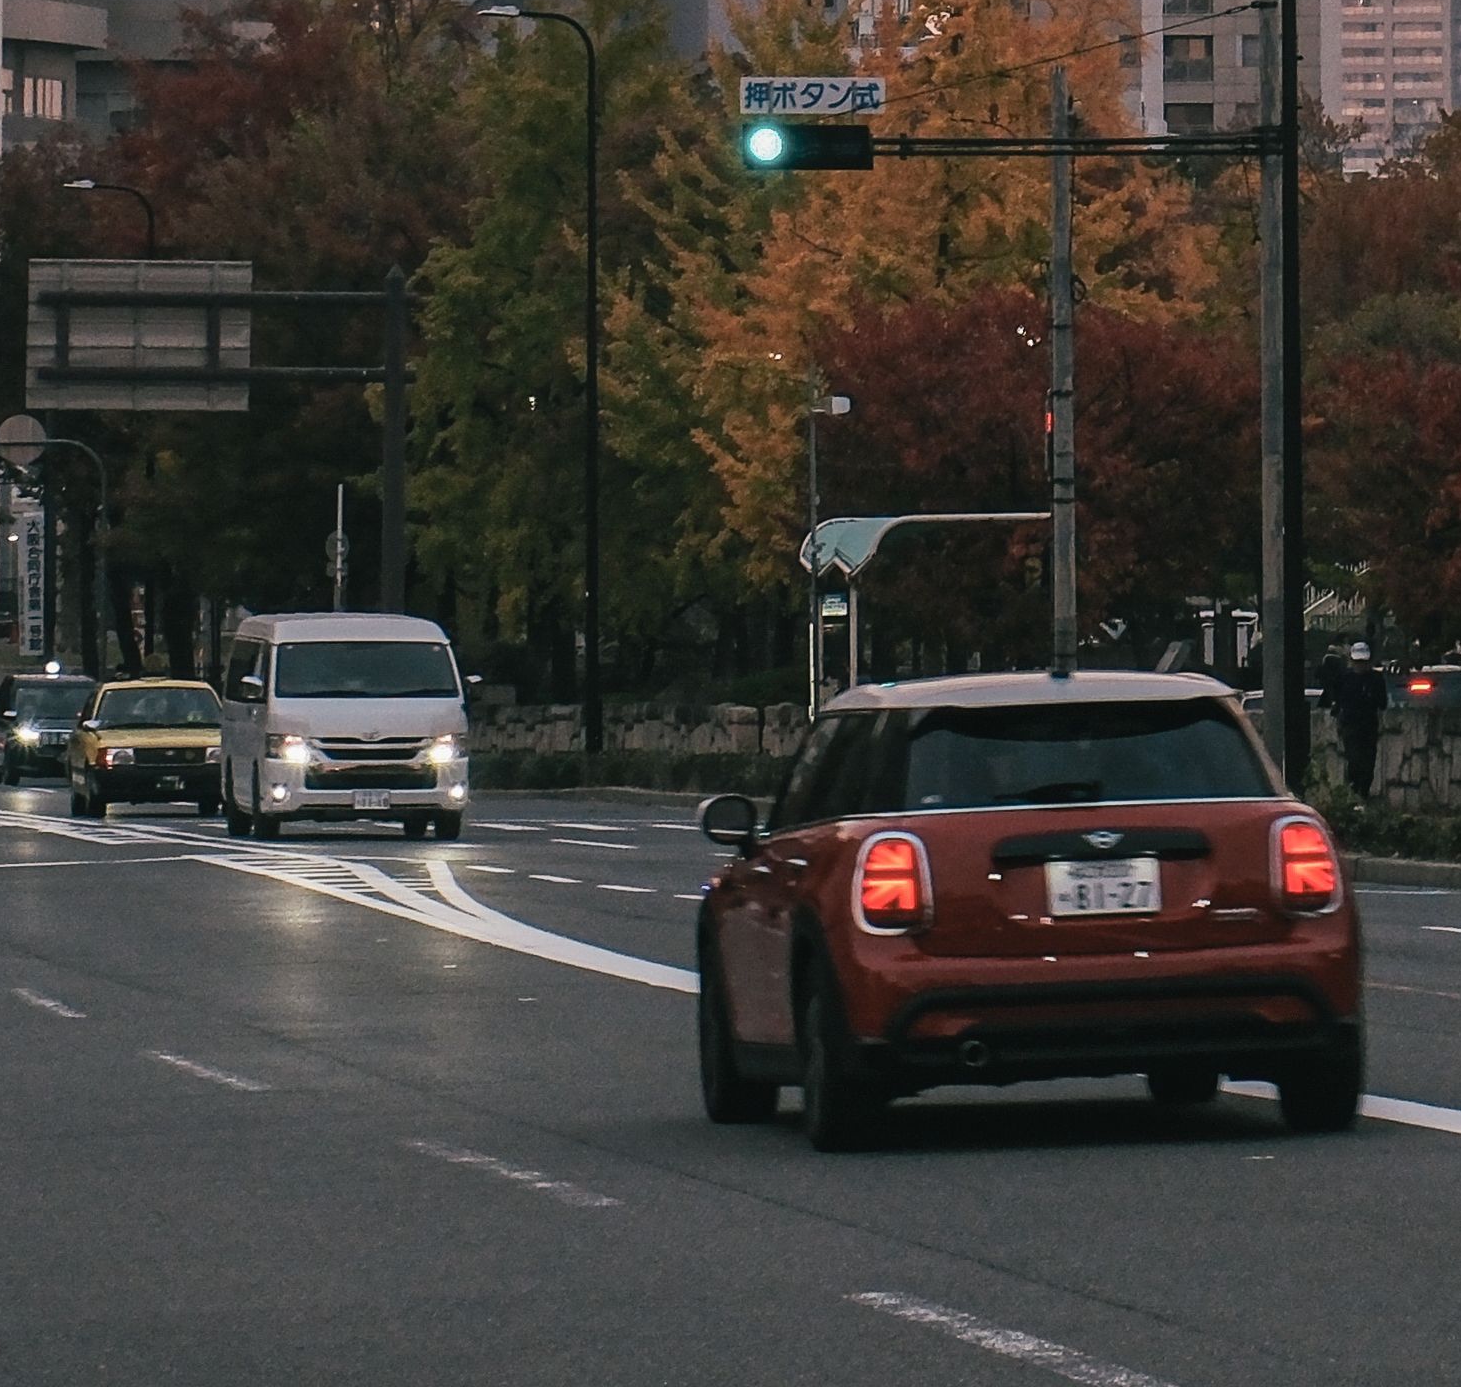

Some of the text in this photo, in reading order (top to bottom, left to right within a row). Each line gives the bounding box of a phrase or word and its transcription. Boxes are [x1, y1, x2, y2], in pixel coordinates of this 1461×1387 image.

[744, 81, 881, 110] 押ボタン式
